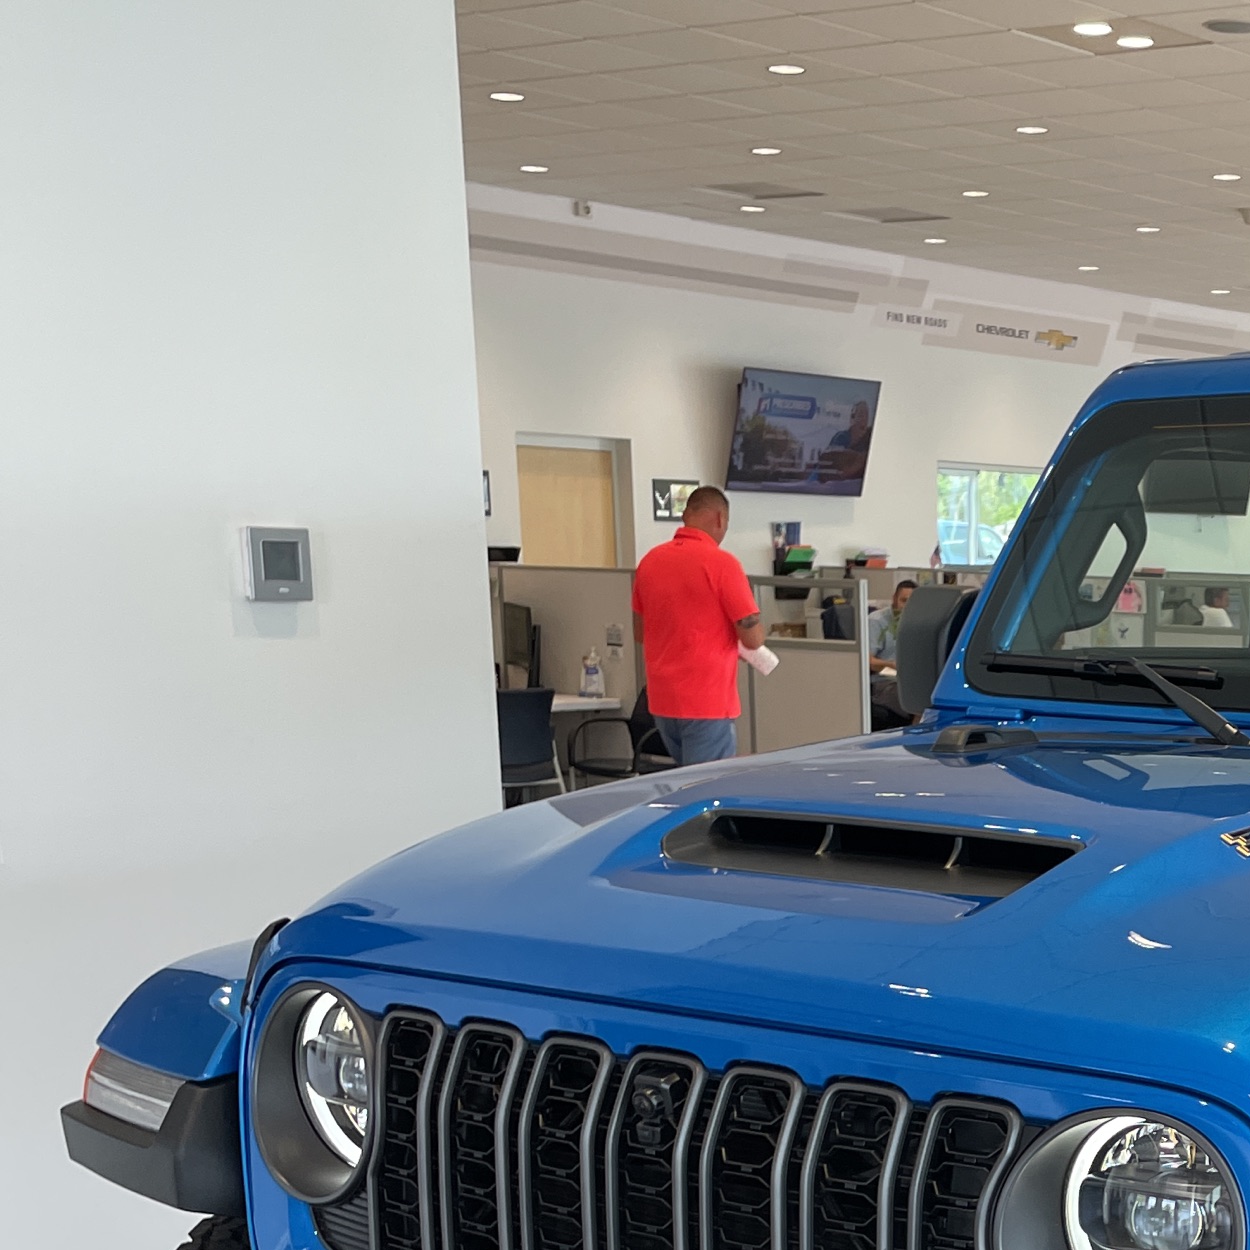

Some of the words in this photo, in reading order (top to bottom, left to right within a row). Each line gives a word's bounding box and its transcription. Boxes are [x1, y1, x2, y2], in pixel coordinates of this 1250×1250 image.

[886, 311, 904, 323] FIND
[906, 313, 922, 324] NEW
[924, 316, 948, 328] ROADS
[976, 323, 1030, 339] CHEVROLET
